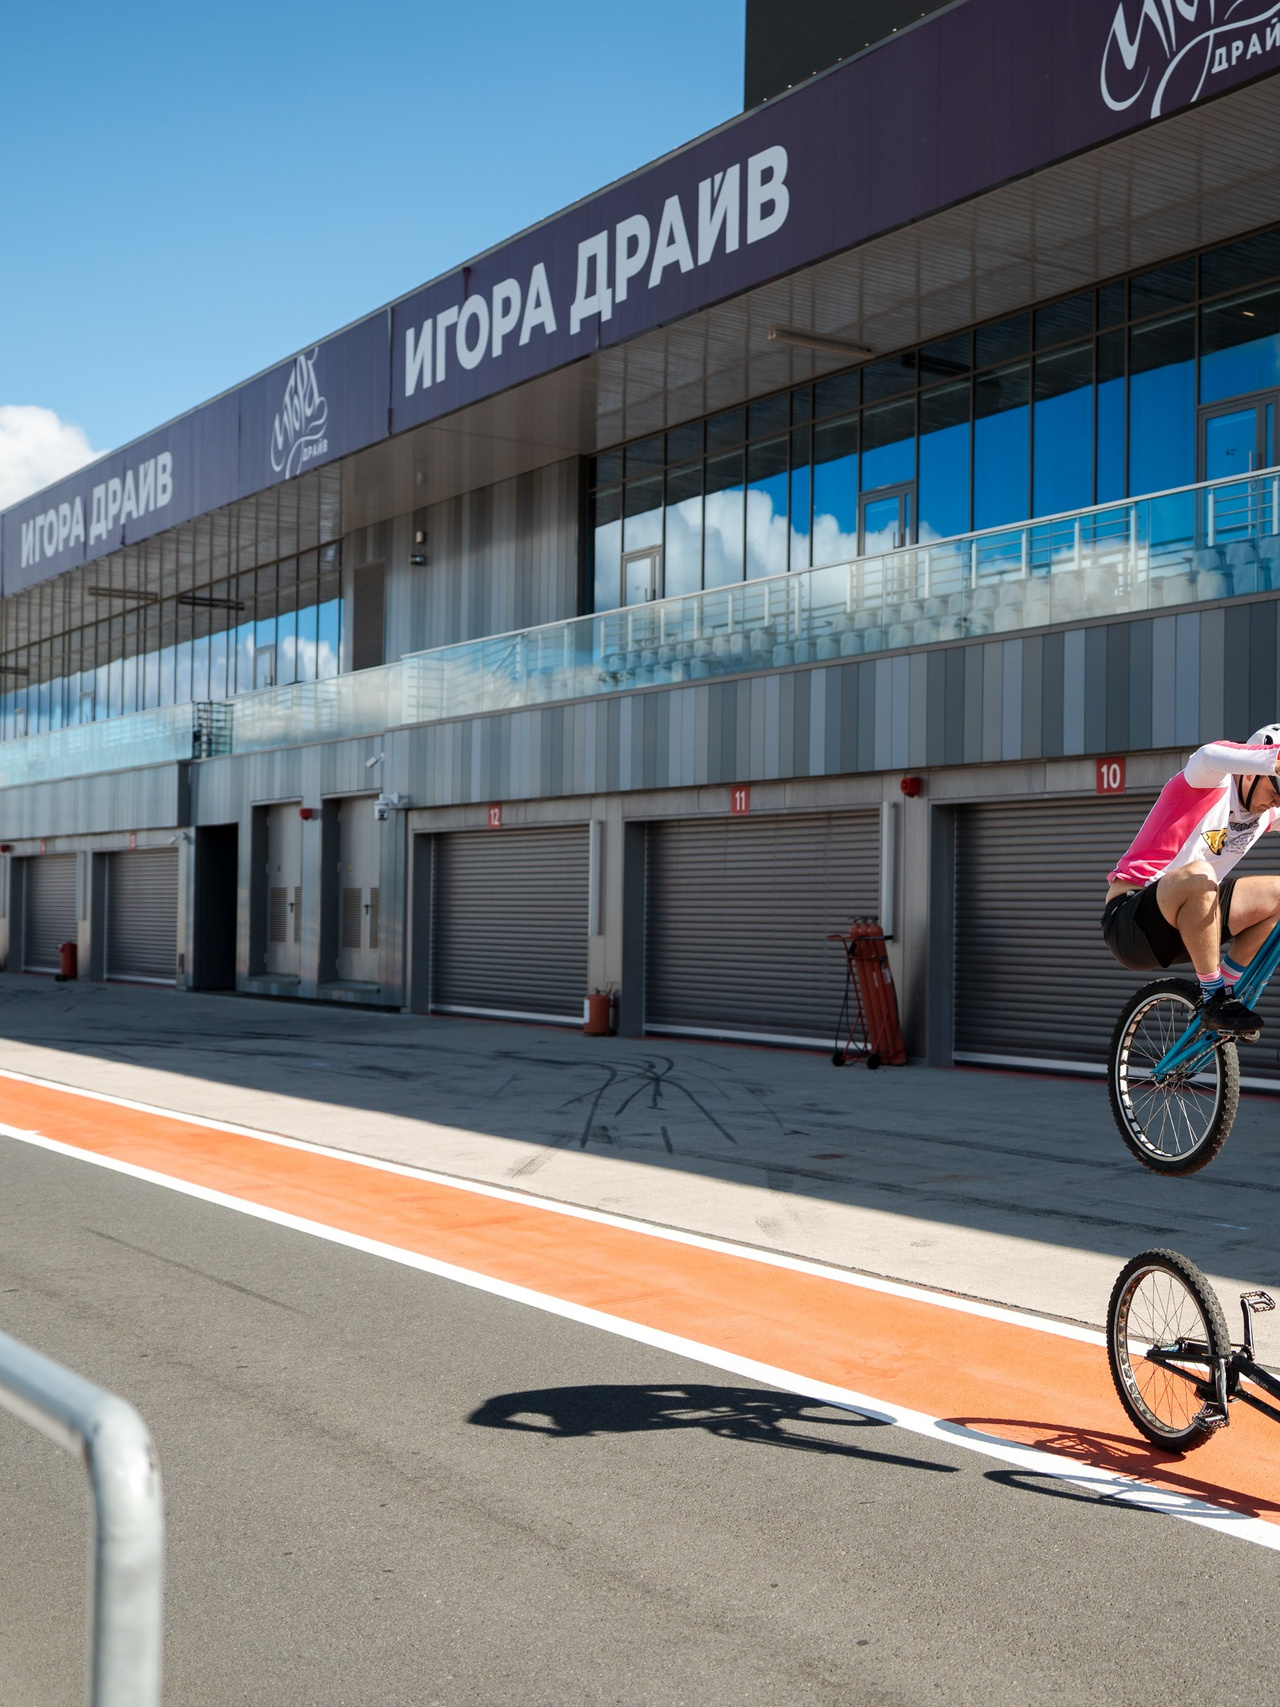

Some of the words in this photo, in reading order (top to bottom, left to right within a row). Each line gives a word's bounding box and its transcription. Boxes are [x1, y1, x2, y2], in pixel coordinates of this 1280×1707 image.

[405, 262, 557, 397] ИГОРА
[570, 145, 790, 336] ДРАЙВ
[302, 438, 328, 461] ДРАЙВ
[21, 496, 85, 569] ИГОРА
[89, 451, 173, 546] ДРАЙВ
[1101, 763, 1121, 789] 10
[735, 790, 745, 811] 11
[490, 808, 499, 825] 12
